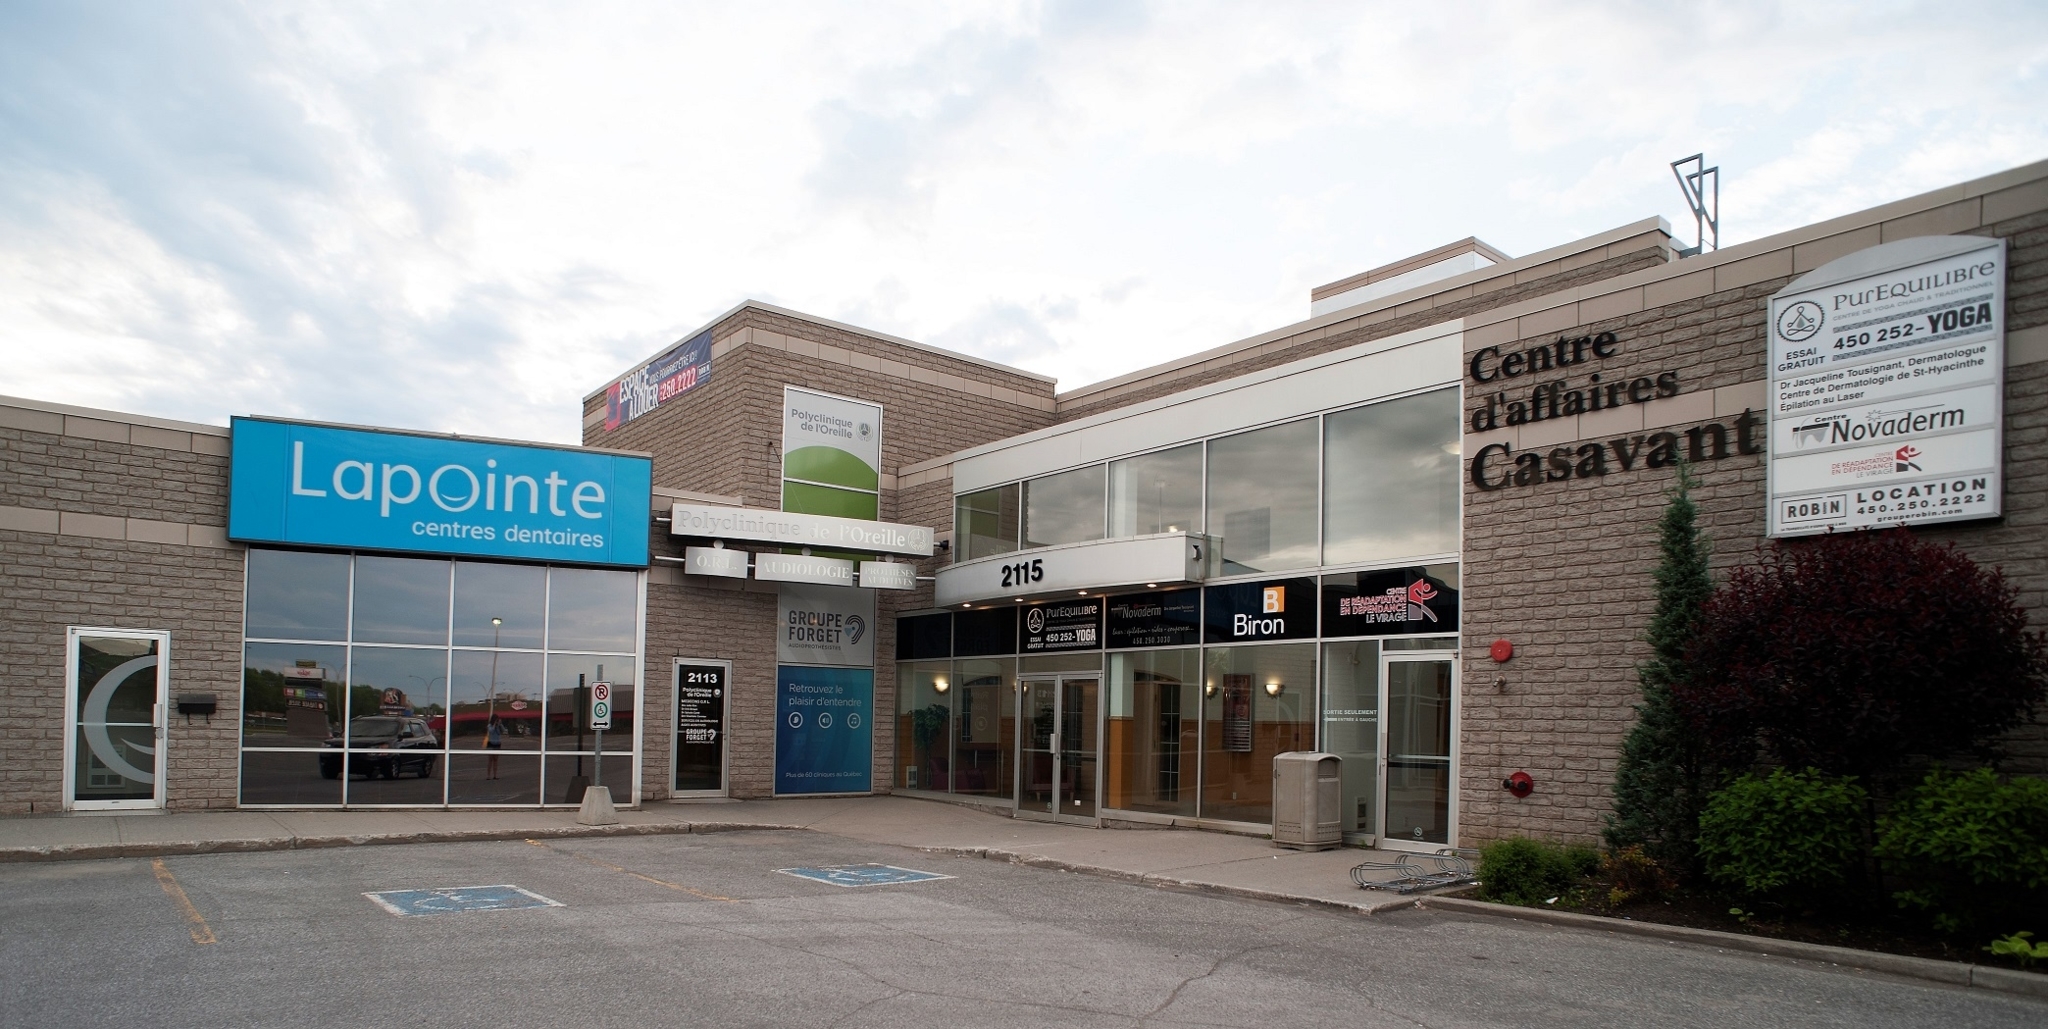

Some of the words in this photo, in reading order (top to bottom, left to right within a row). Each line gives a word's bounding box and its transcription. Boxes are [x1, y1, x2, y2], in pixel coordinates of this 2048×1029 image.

[1833, 311, 1860, 321] CENTRE
[1874, 304, 1895, 312] YOGA
[1897, 297, 1925, 307] CHAUD
[1935, 281, 1994, 298] TRADITIONNEL
[1833, 333, 1870, 349] 450
[1470, 331, 1617, 383] Centre
[1786, 347, 1817, 360] ESSAI
[1778, 356, 1825, 371] GRATUIT
[1781, 382, 1791, 390] Dr
[1793, 373, 1844, 388] Jacqueline
[1847, 361, 1905, 378] Tousignant,
[1908, 346, 1987, 366] Dermatologue
[619, 364, 650, 404] ESPACE
[1780, 389, 1811, 400] Centre
[1813, 387, 1825, 395] de
[1828, 375, 1894, 392] Dermatologie
[1897, 372, 1910, 380] de
[1913, 358, 1984, 377] St-Hyacinthe
[1471, 371, 1679, 432] d'affaires
[1780, 398, 1820, 412] Épilation
[1823, 396, 1834, 404] au
[1837, 391, 1865, 402] Laser
[791, 408, 853, 428] Polyclinique
[1814, 414, 1847, 423] Centre
[1831, 408, 1964, 443] Novaderm
[800, 421, 814, 431] de
[815, 423, 853, 439] l'Oreille
[1470, 407, 1761, 491] Casavant
[291, 440, 605, 519] Lapointe
[1866, 468, 1894, 476] VIRAGE
[1857, 478, 1986, 503] LOCATION
[1787, 500, 1840, 518] ROBIN
[1857, 494, 1986, 515] 450.250.2222
[1877, 508, 1962, 522] grouperobin.com
[411, 518, 496, 541] centres
[504, 524, 603, 548] dentaires
[678, 510, 801, 540] Polyclinique
[809, 523, 830, 539] de
[839, 524, 905, 547] l'Oreille
[696, 555, 737, 570] O.R.L.
[763, 562, 850, 579] AUDIOLOGIE
[1001, 558, 1043, 587] 2115
[1386, 586, 1407, 595] CENTRE
[1340, 598, 1350, 607] DE
[1340, 606, 1351, 616] EN
[788, 610, 842, 628] GROUPE
[1122, 606, 1162, 619] Novaderm
[1366, 614, 1375, 623] LE
[1375, 612, 1407, 623] VIRAGE
[1233, 613, 1285, 636] Biron
[788, 626, 842, 643] FORGET
[1046, 633, 1059, 642] 450
[687, 672, 718, 684] 2113
[788, 683, 834, 694] Retrouvez
[835, 685, 843, 694] le
[788, 696, 815, 707] plaisir
[816, 697, 862, 707] d'entendre
[813, 771, 835, 779] cliniques
